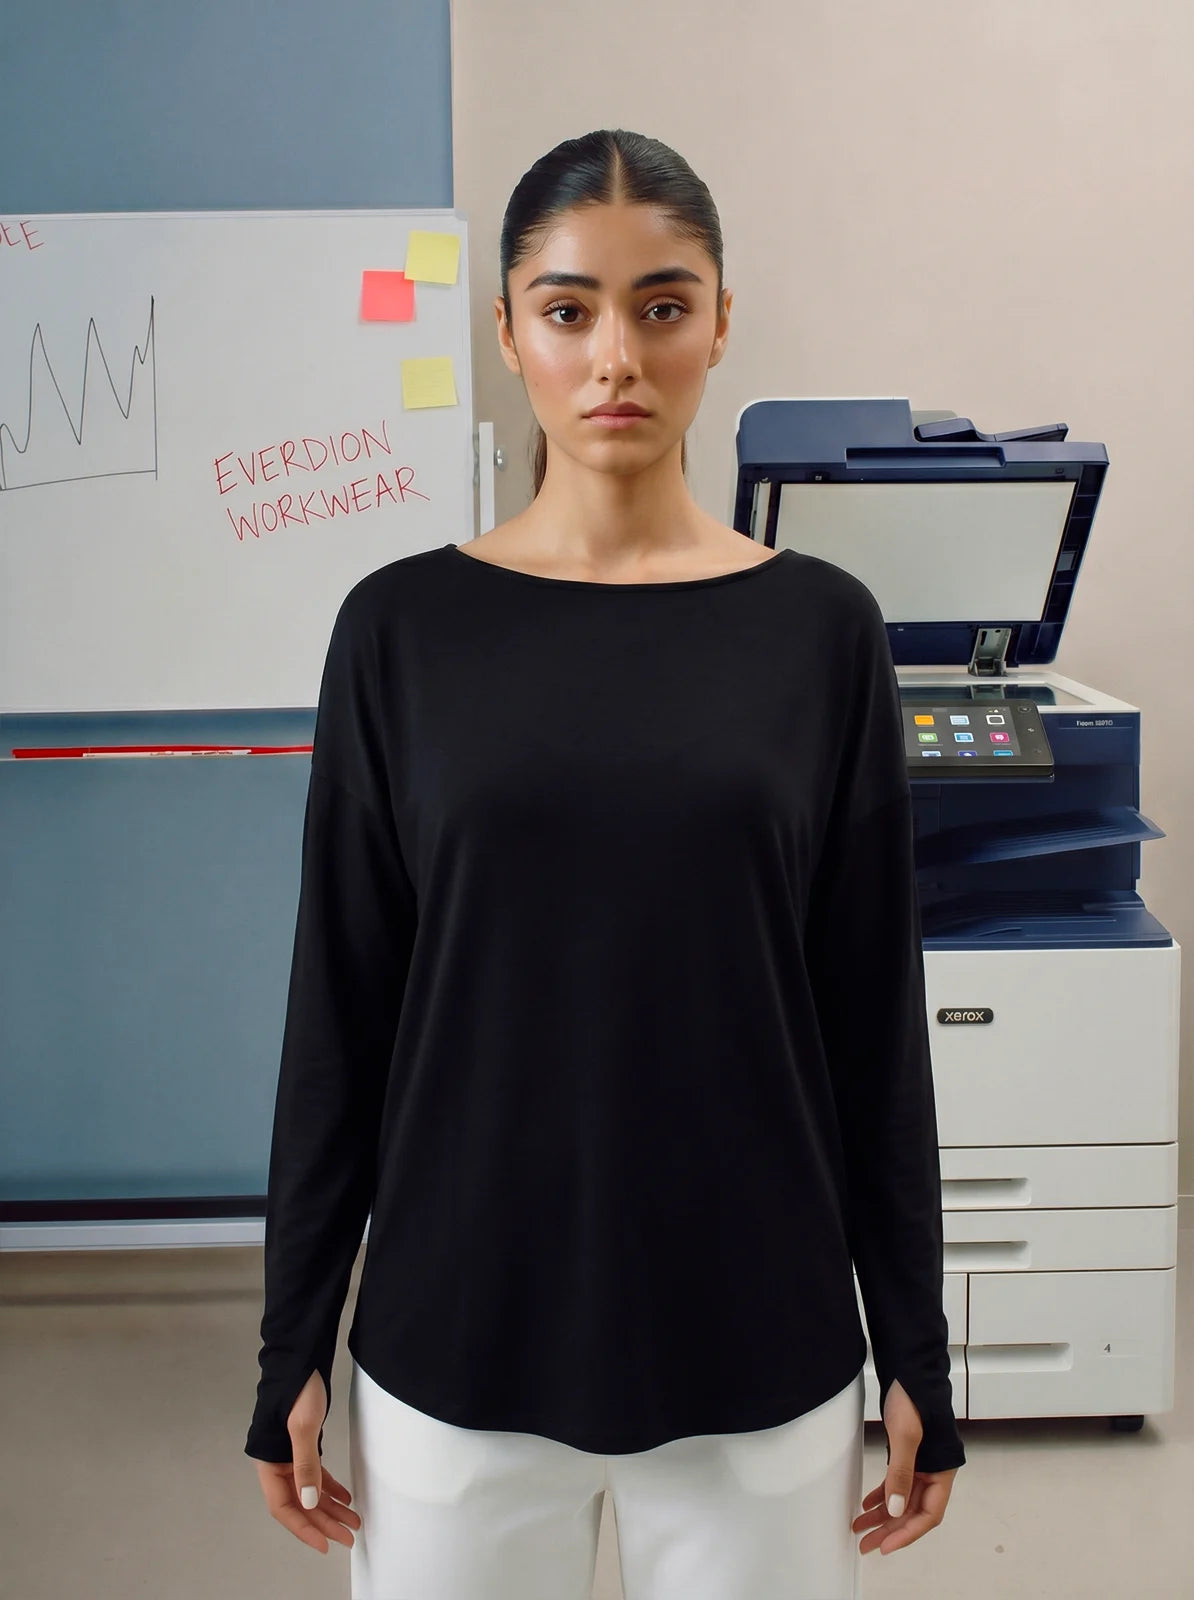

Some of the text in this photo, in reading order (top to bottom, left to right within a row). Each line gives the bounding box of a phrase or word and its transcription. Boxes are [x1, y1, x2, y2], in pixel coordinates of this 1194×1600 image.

[213, 420, 392, 496] EVERDION
[226, 466, 431, 542] WORKWEAR
[944, 1011, 985, 1022] xerox
[1103, 1343, 1111, 1354] 4
